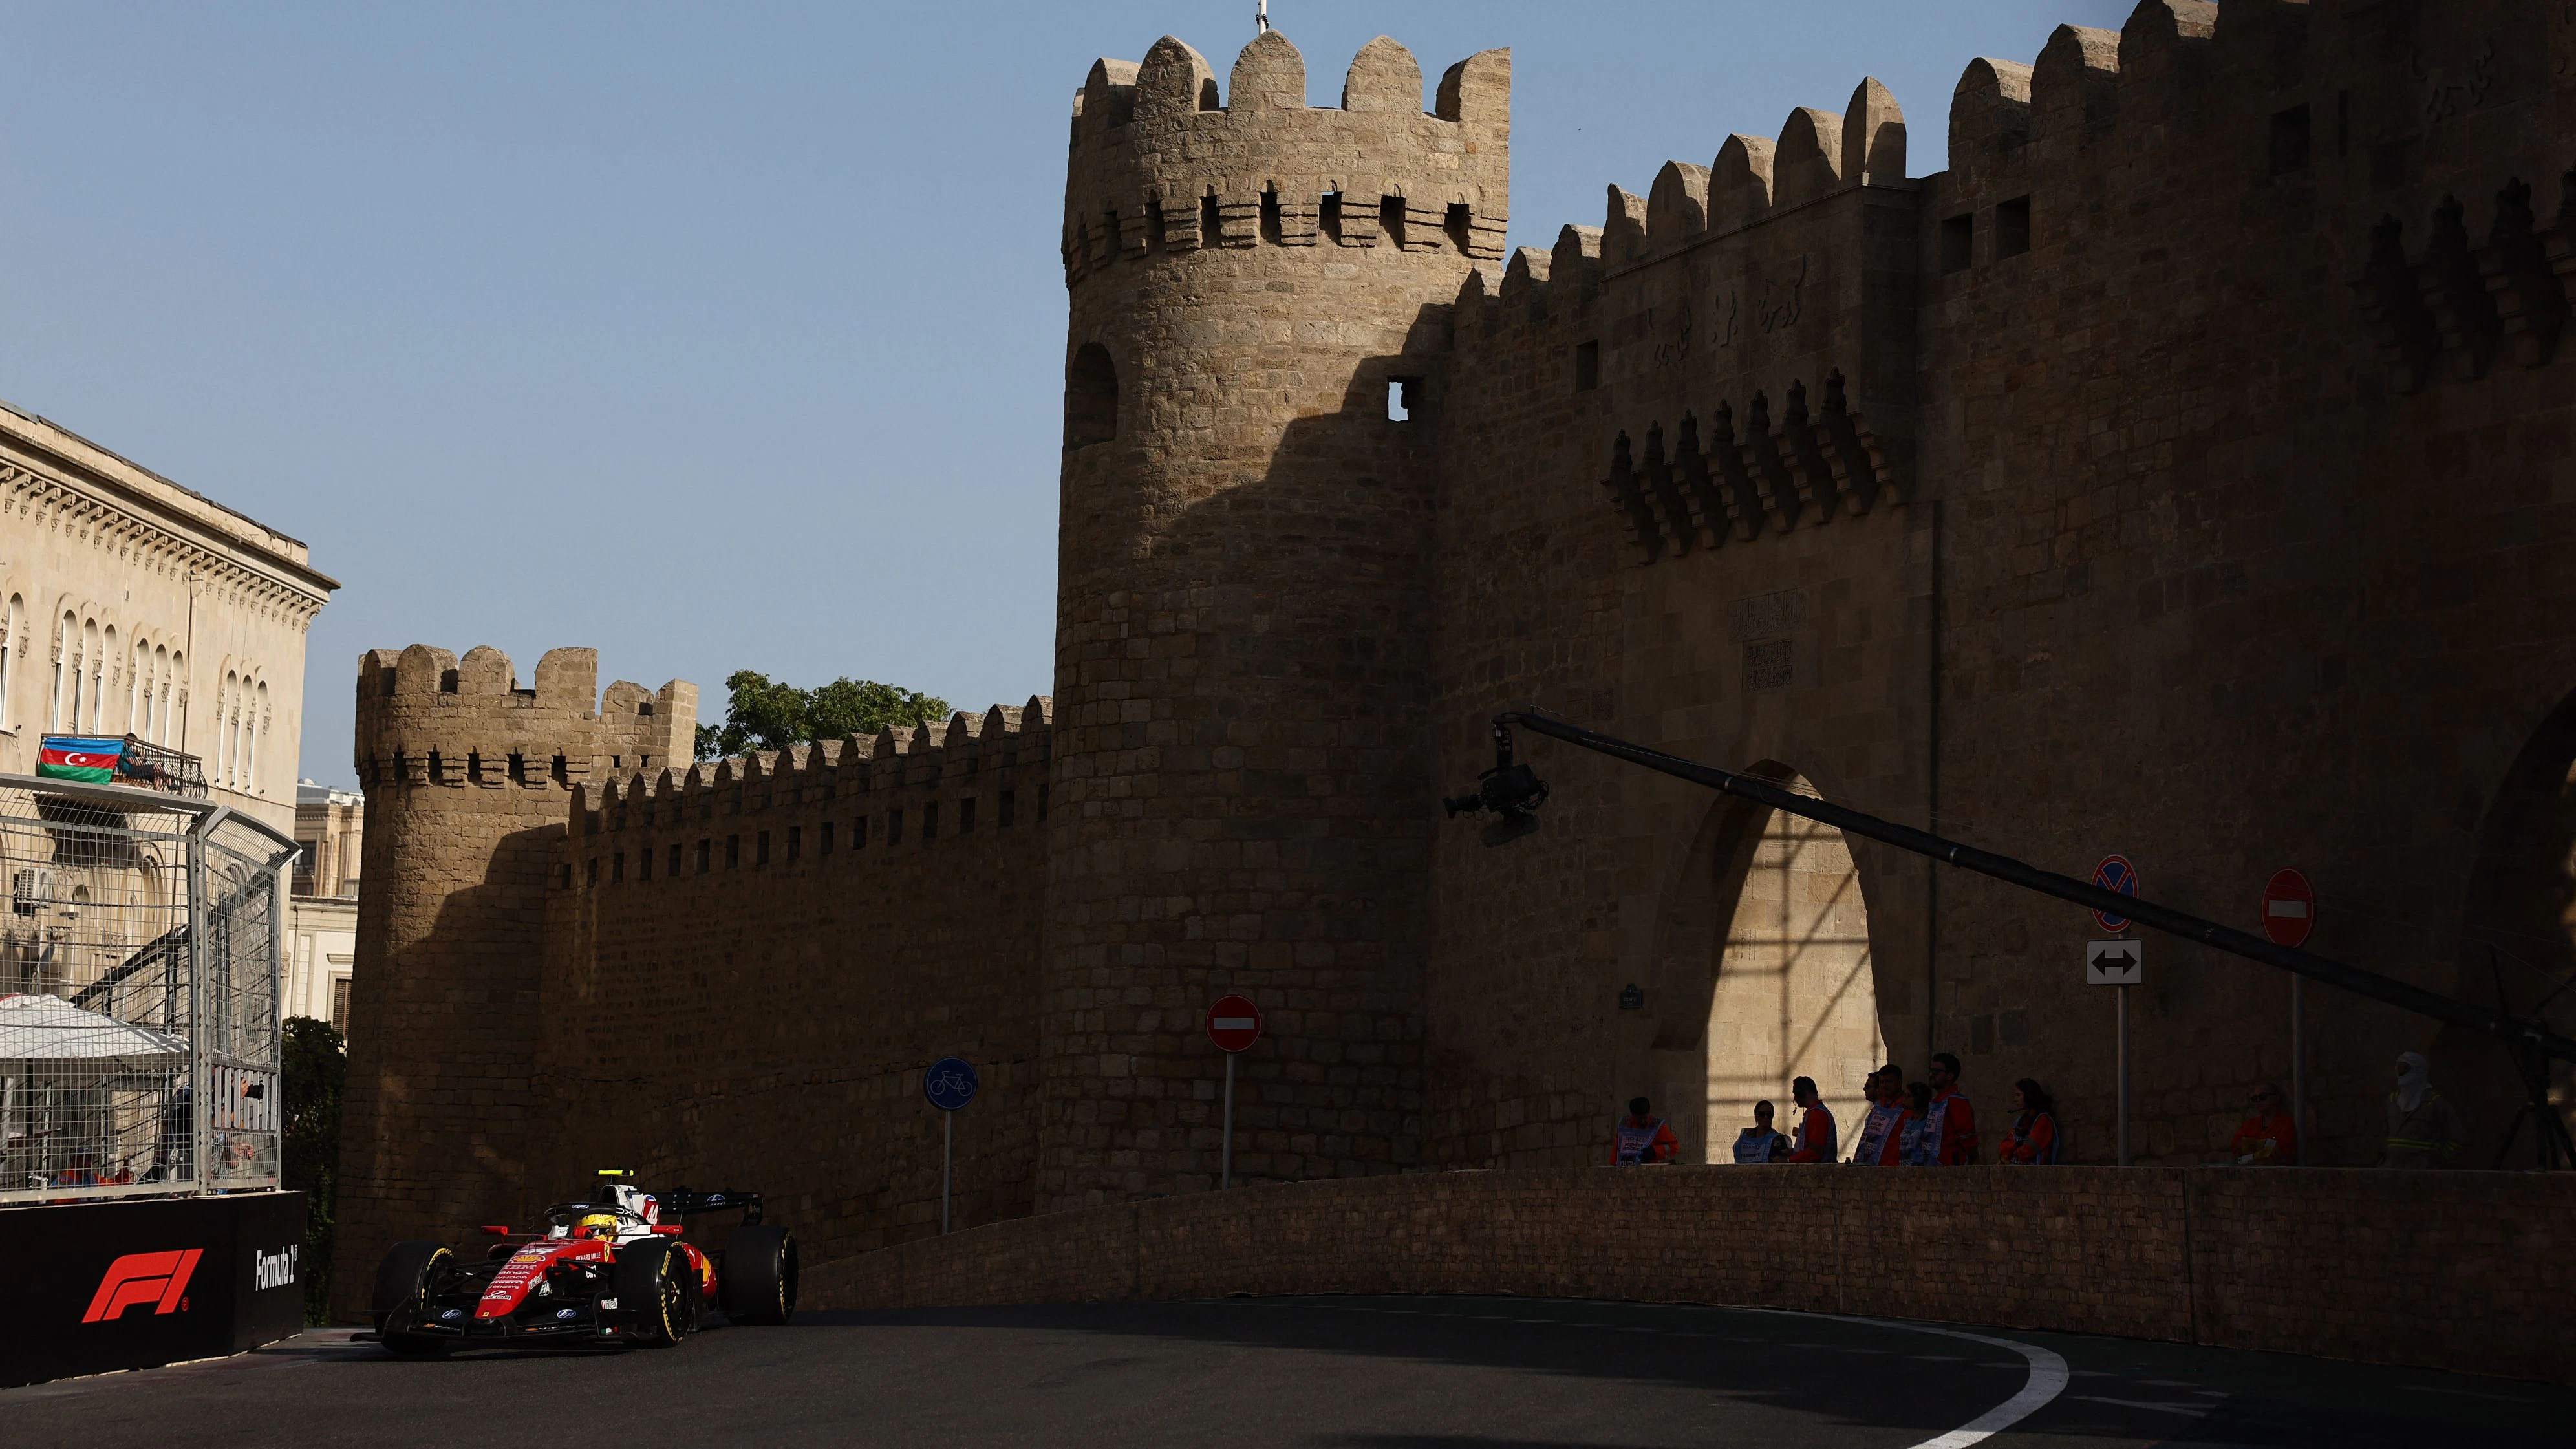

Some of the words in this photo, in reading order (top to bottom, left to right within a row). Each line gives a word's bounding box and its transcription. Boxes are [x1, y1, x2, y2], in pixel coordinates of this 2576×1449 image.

[255, 1245, 289, 1291] Formula
[81, 1248, 204, 1324] F1
[442, 1309, 461, 1319] hp
[557, 1309, 576, 1318] hp
